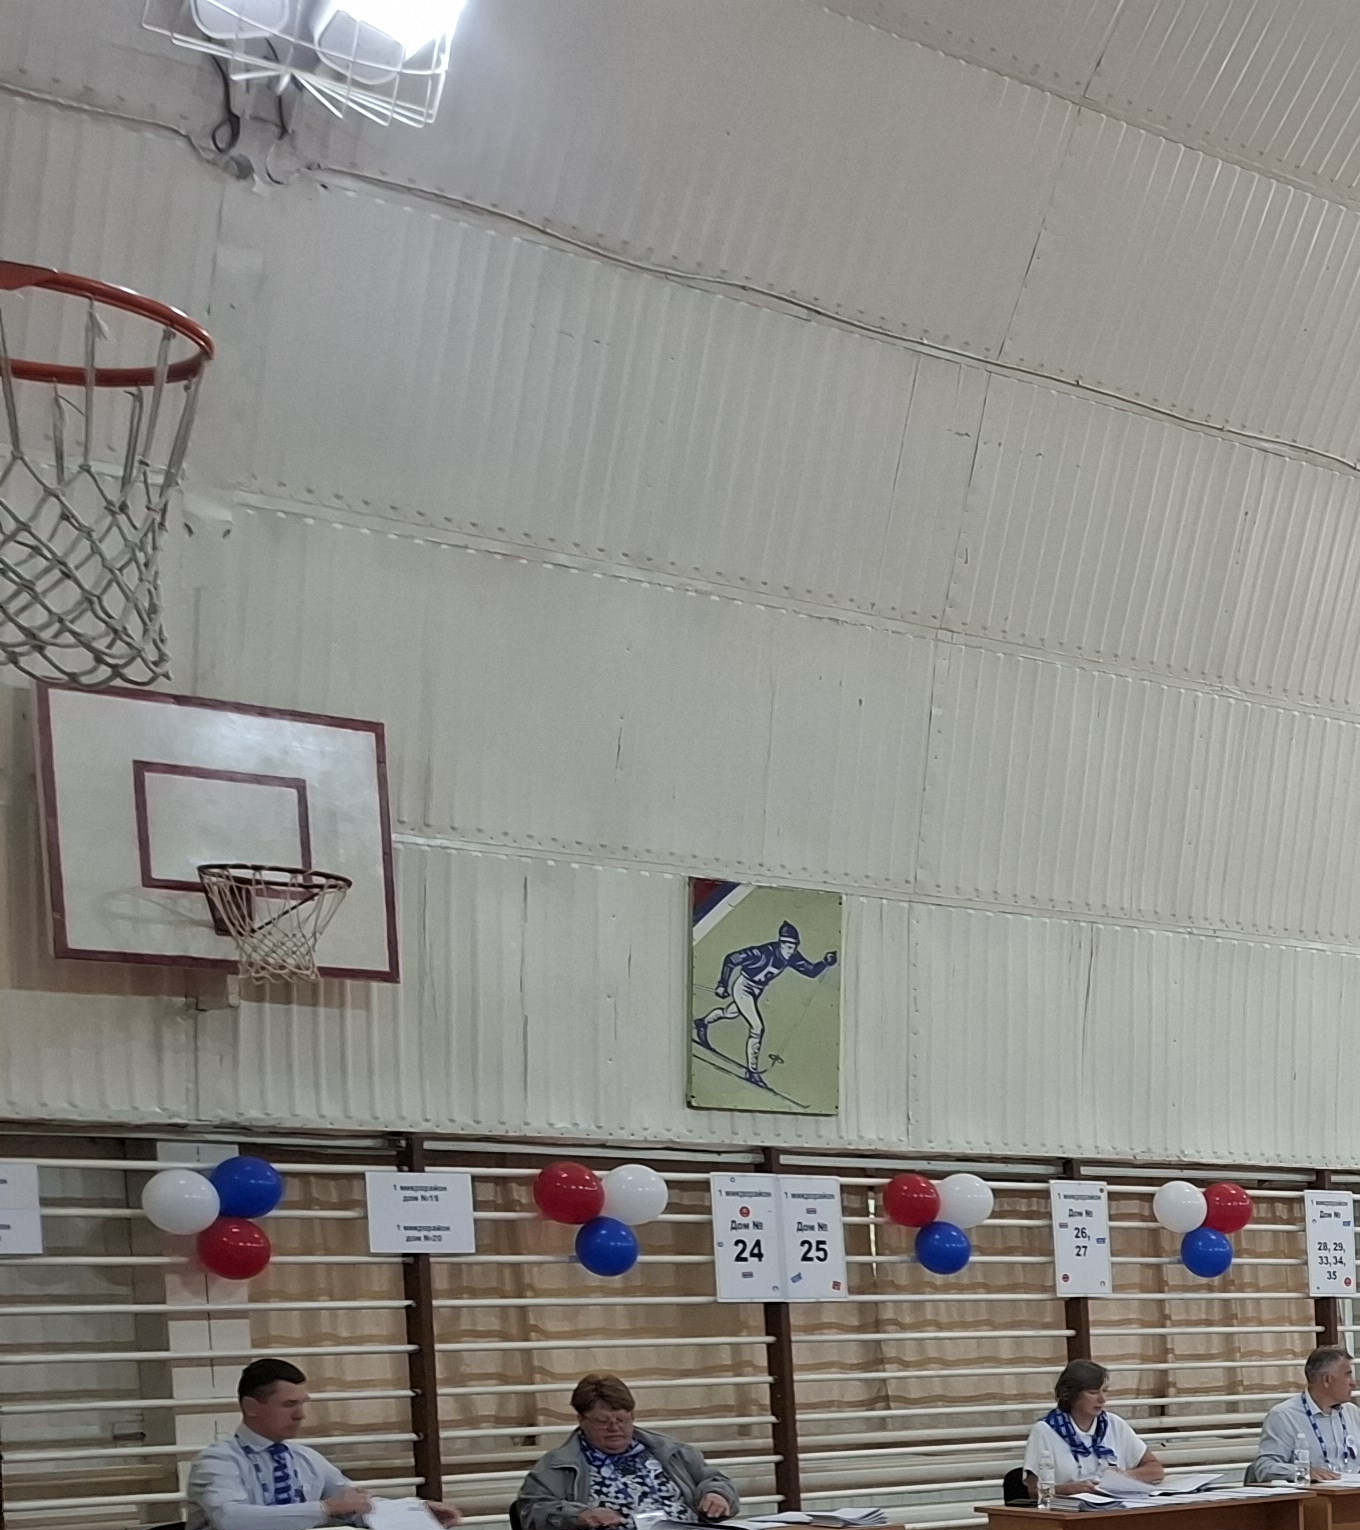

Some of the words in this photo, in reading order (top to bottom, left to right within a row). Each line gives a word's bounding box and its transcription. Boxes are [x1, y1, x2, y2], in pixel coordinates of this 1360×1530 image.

[730, 1220, 749, 1231] Дом
[752, 1220, 763, 1230] №
[796, 1221, 815, 1233] Дом
[817, 1222, 828, 1231] №
[1074, 1227, 1091, 1241] 26,
[733, 1239, 764, 1262] 24
[800, 1240, 828, 1262] 25
[1075, 1245, 1088, 1257] 27
[1326, 1271, 1337, 1280] 35
